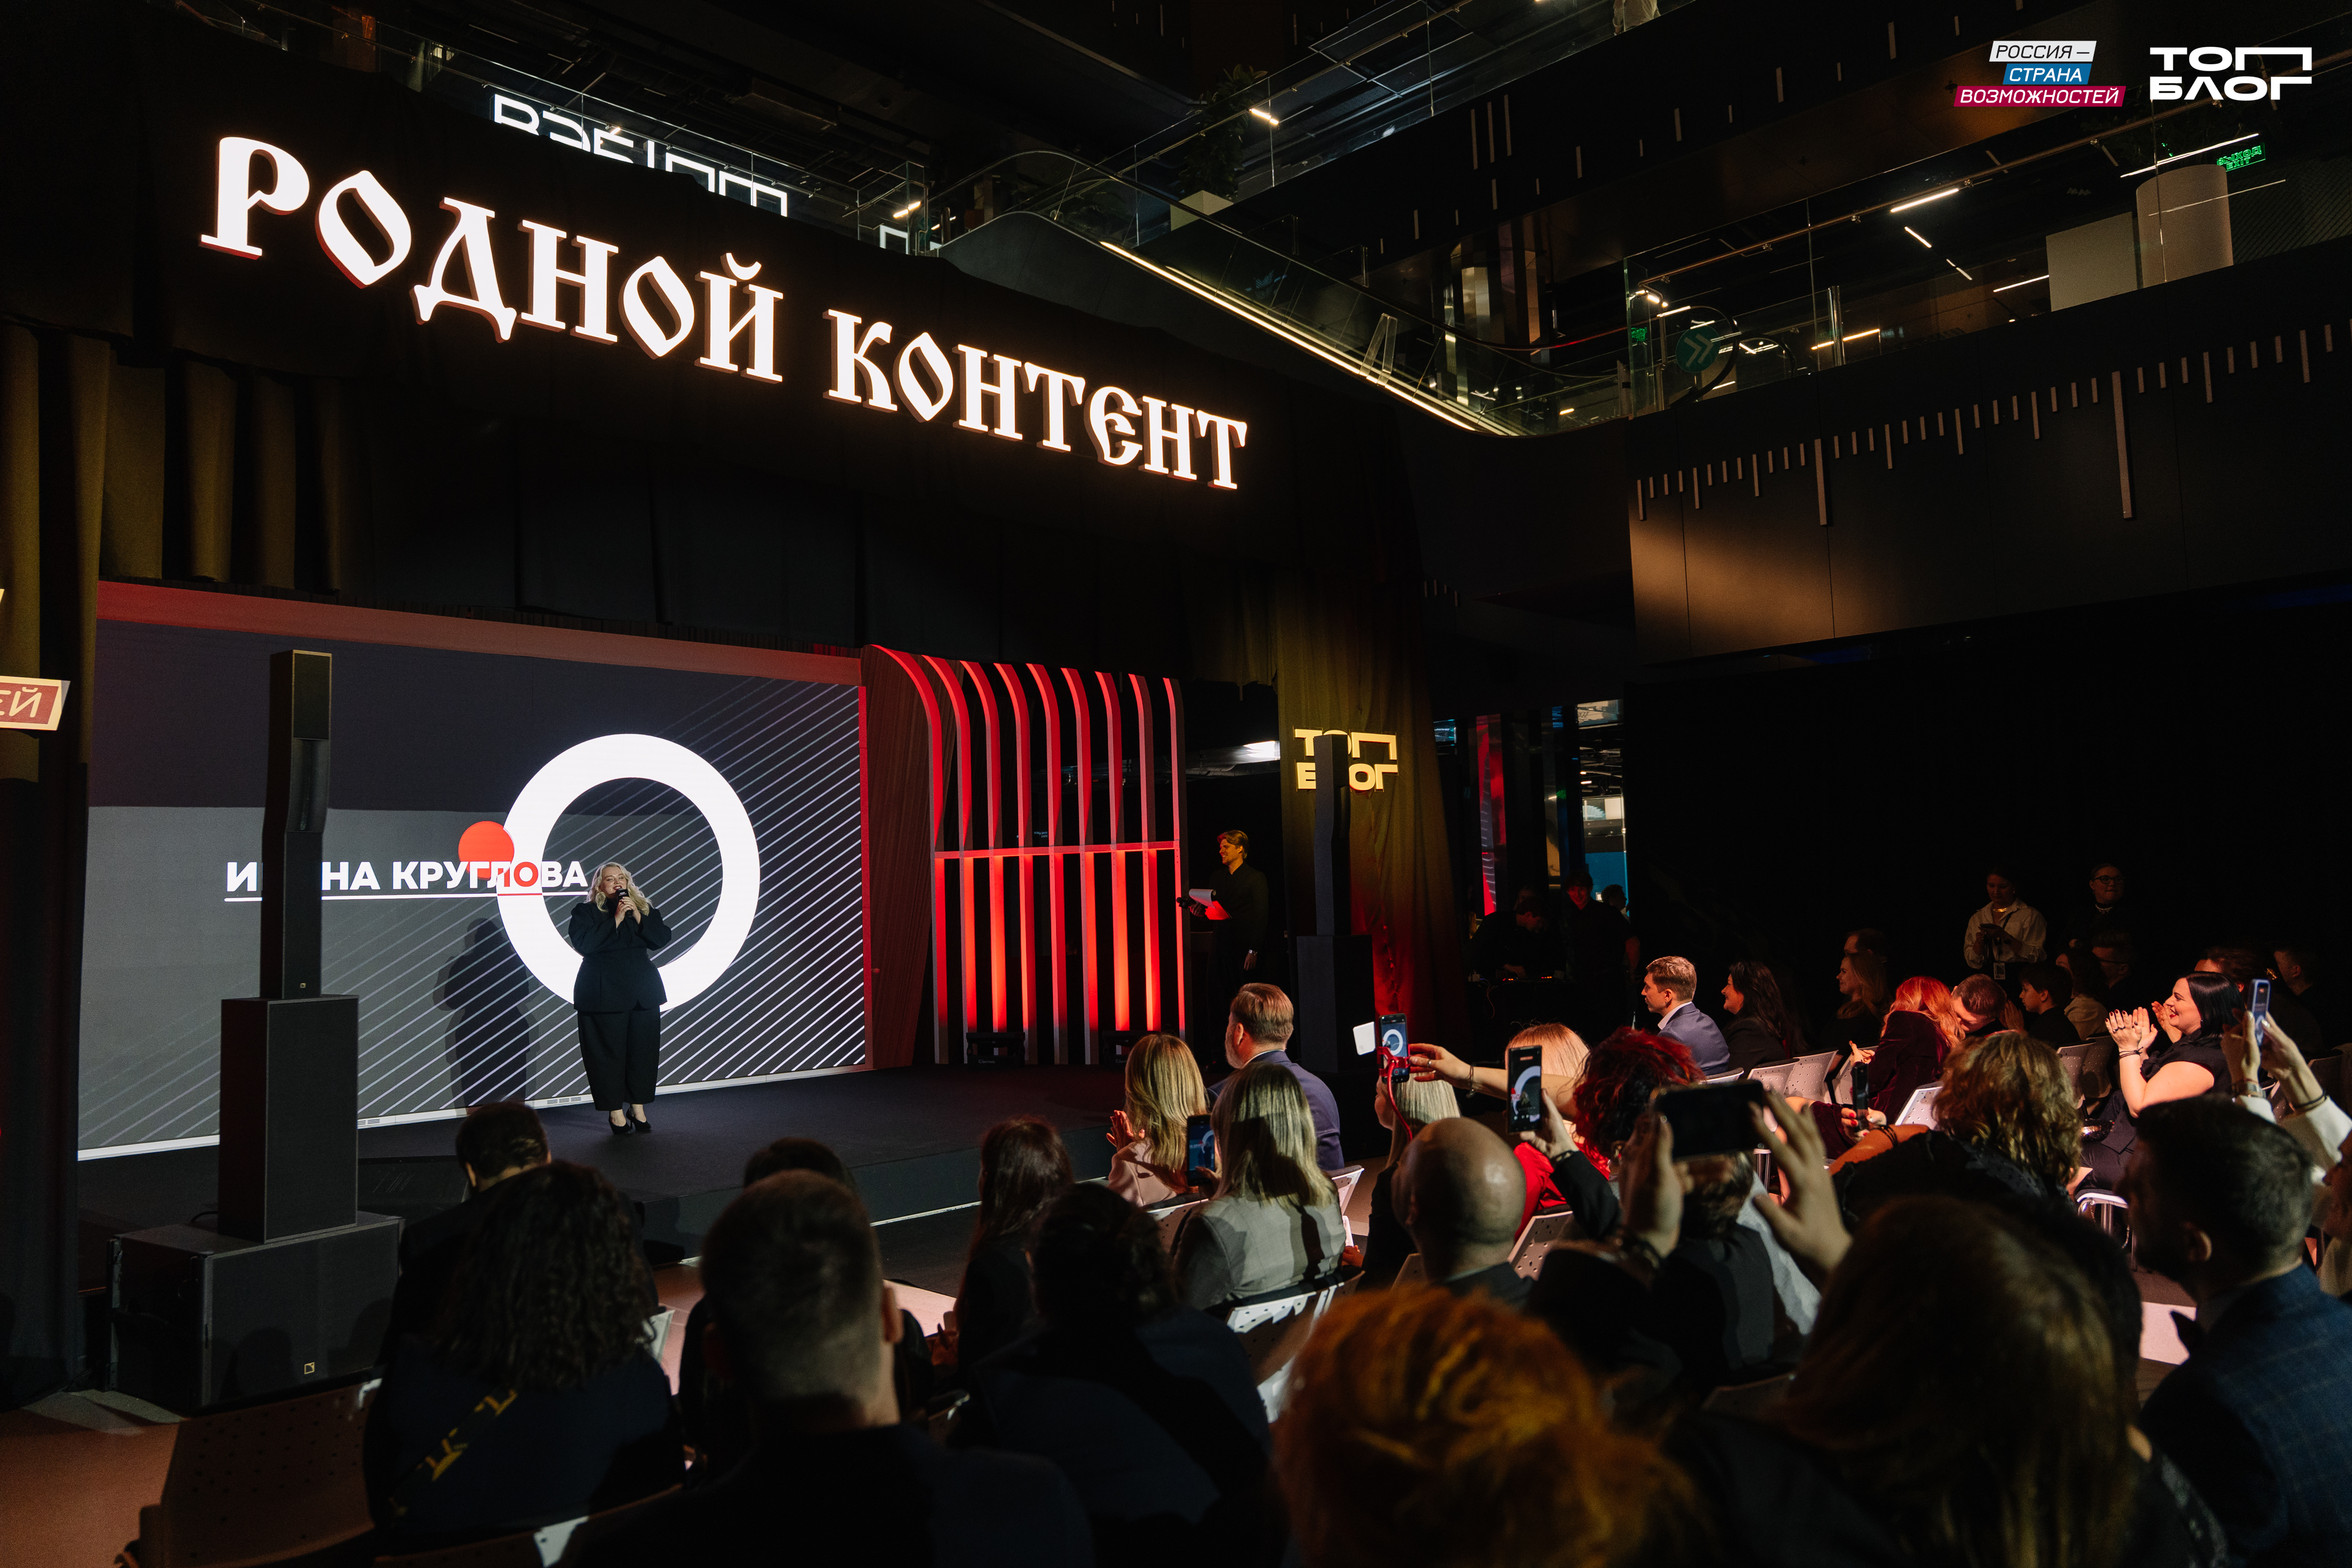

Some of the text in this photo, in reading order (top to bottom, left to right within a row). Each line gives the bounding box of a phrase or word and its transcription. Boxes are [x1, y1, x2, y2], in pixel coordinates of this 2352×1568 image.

[2226, 156, 2251, 170] EXIT
[199, 136, 783, 383] РОДНОЙ
[1297, 763, 1398, 791] БОГ
[226, 861, 588, 892] ИНА КРУГЛОВА
